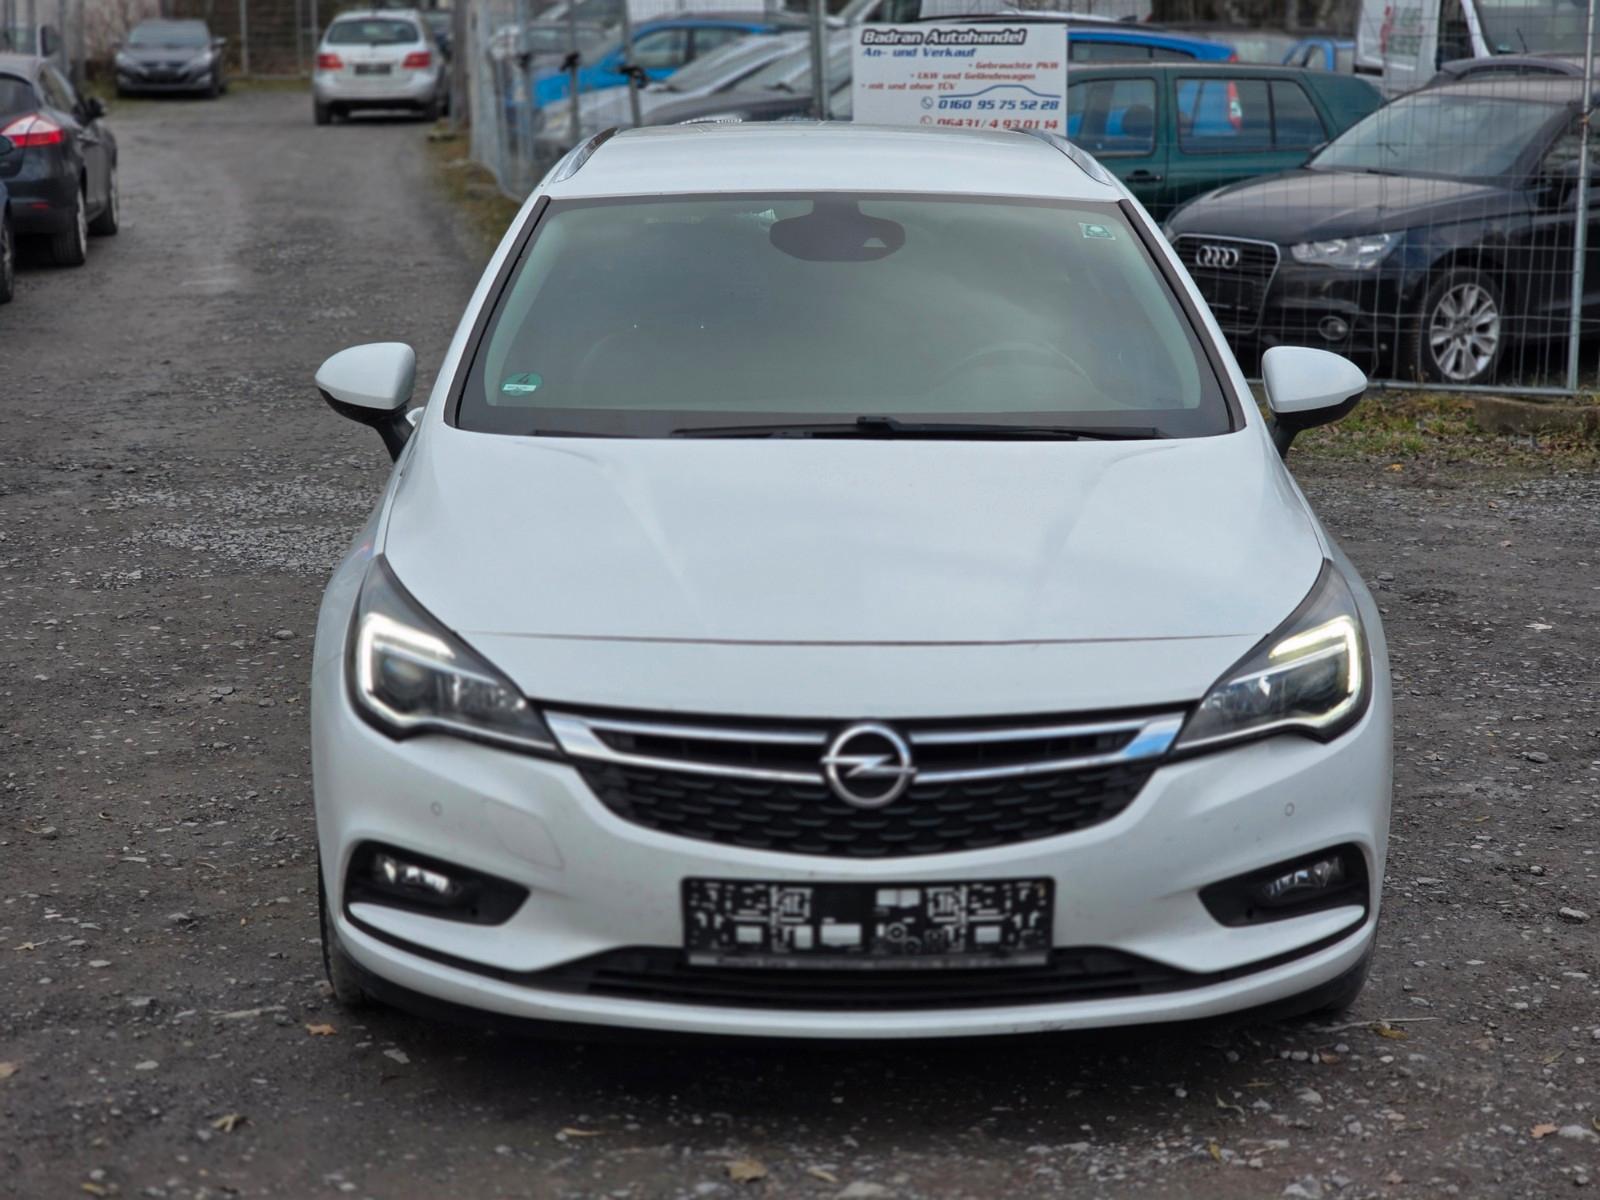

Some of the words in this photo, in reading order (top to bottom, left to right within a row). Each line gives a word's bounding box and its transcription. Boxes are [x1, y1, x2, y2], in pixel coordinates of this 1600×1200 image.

[862, 30, 923, 45] Badran
[925, 29, 1026, 45] Autohandel
[893, 48, 918, 57] und
[923, 47, 976, 57] Verkauf
[976, 62, 1033, 70] Gebrauchte
[1036, 62, 1059, 70] PKW
[964, 72, 1036, 81] Geländewagen
[937, 81, 957, 90] TÜV
[938, 100, 973, 110] 0160
[977, 100, 995, 110] 95
[1000, 100, 1017, 110] 75
[1020, 100, 1038, 110] 52
[1040, 100, 1059, 110] 28
